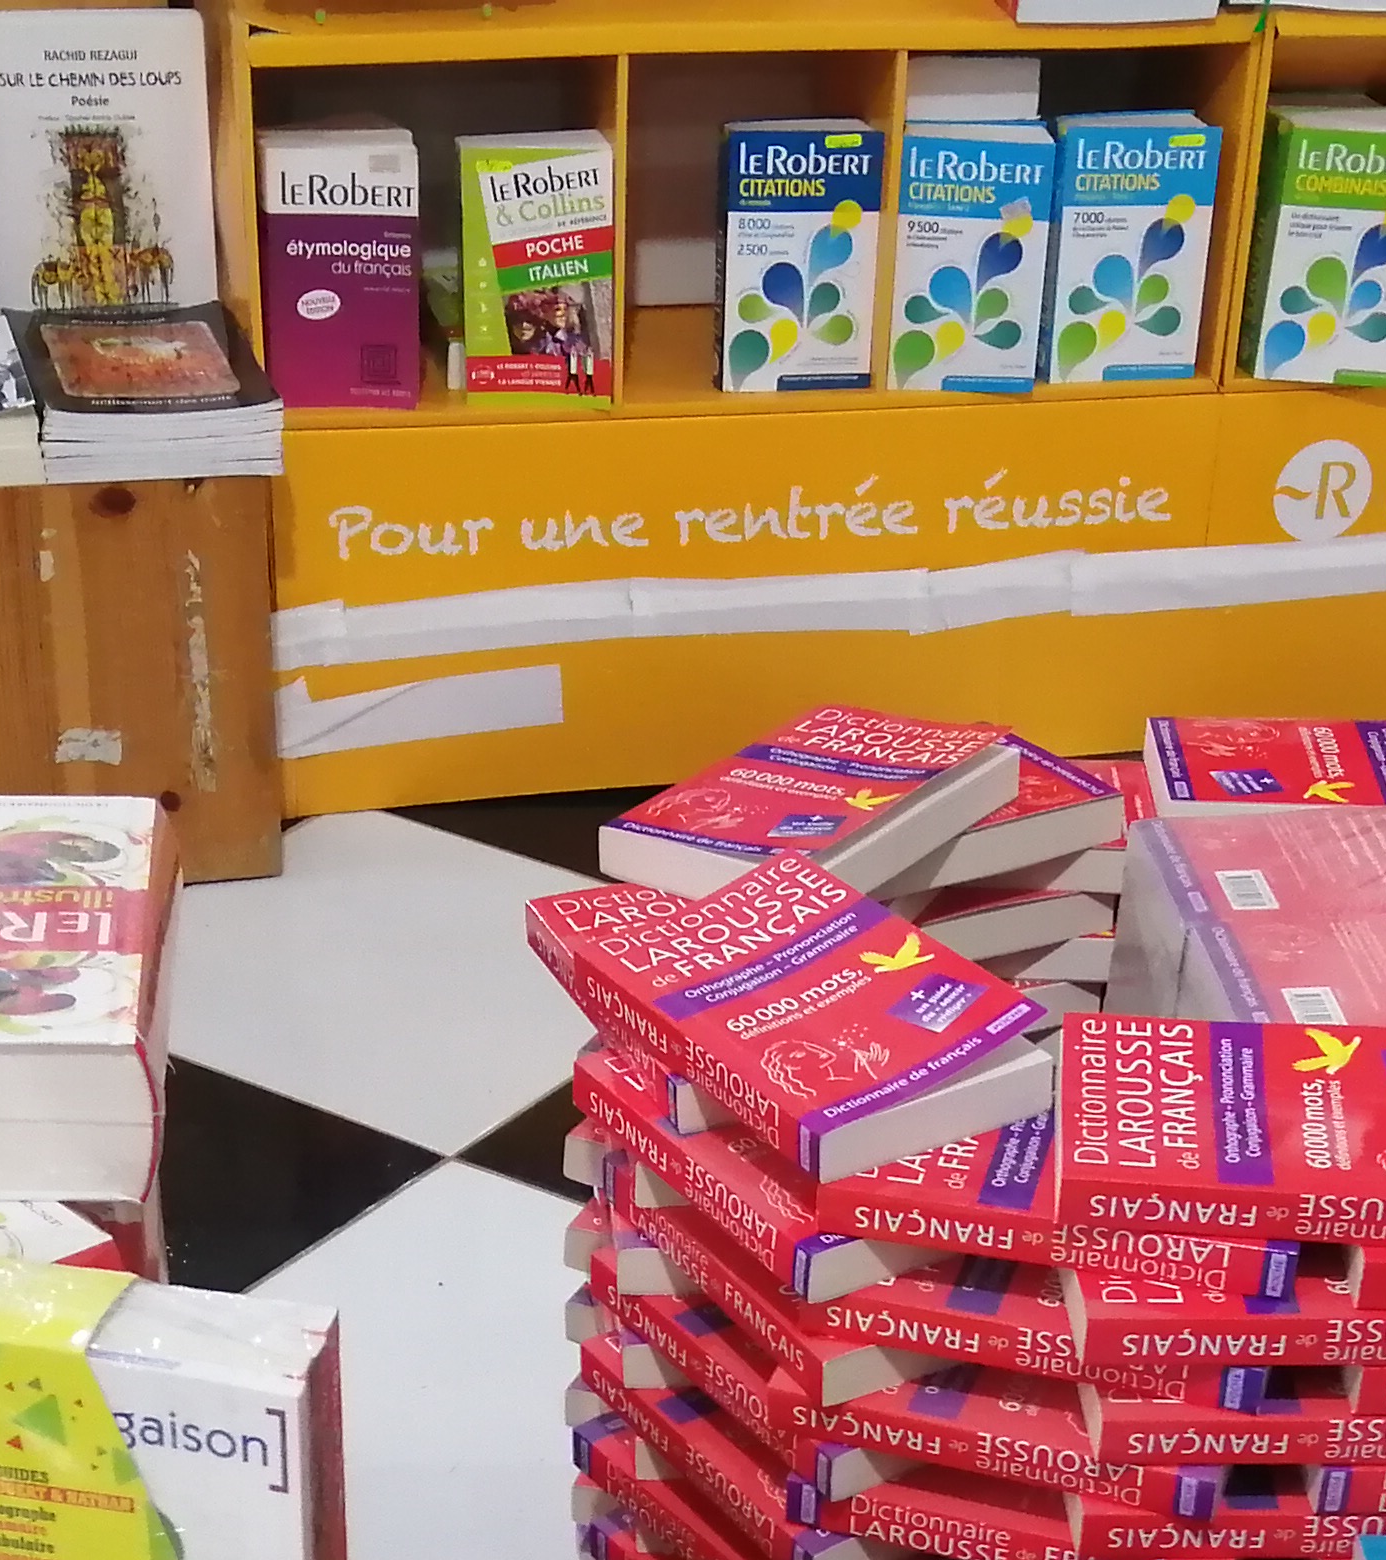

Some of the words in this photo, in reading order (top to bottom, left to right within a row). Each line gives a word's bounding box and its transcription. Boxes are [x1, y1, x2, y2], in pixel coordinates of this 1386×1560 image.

[43, 49, 86, 62] RACHID
[0, 72, 25, 87] SUR
[29, 72, 44, 87] LE
[48, 72, 105, 88] CHEMIN
[109, 72, 136, 86] DES
[139, 71, 182, 86] LOUPS
[71, 94, 110, 108] Poésie
[739, 178, 825, 198] CITATIONS
[909, 182, 996, 204] CITATIONS
[1075, 173, 1160, 192] CITATIONS
[496, 204, 513, 226] &
[519, 192, 604, 222] Collins
[286, 238, 412, 258] étymologique
[525, 235, 585, 257] POCHE
[331, 260, 351, 275] du
[354, 260, 412, 277] français
[528, 258, 588, 281] ITALIEN
[328, 503, 494, 560] Pour
[520, 507, 650, 552] une
[675, 475, 919, 546] rentrée
[944, 468, 1172, 532] réussie
[794, 720, 980, 753] LAROUSSE
[815, 708, 1012, 742] Dictionnaire
[803, 735, 959, 765] FRANÇAIS
[598, 858, 799, 958] Dictionnaire
[619, 867, 828, 974] LAROUSSE
[652, 972, 679, 989] de
[676, 884, 849, 978] FRANÇAIS
[685, 961, 765, 1001] Orthographe
[772, 910, 858, 963] Prononciation
[705, 968, 784, 1005] Conjugaison
[790, 923, 859, 969] Grammaire
[822, 1078, 909, 1121] Dictionnaire
[928, 1036, 983, 1072] français
[1075, 1019, 1109, 1168] Dictionnaire
[1161, 1024, 1203, 1150] FRANÇAIS
[1116, 1021, 1155, 1170] LAROUSSE
[1183, 1151, 1201, 1170] de
[1089, 1193, 1259, 1228] FRANÇAIS
[1266, 1206, 1289, 1219] de
